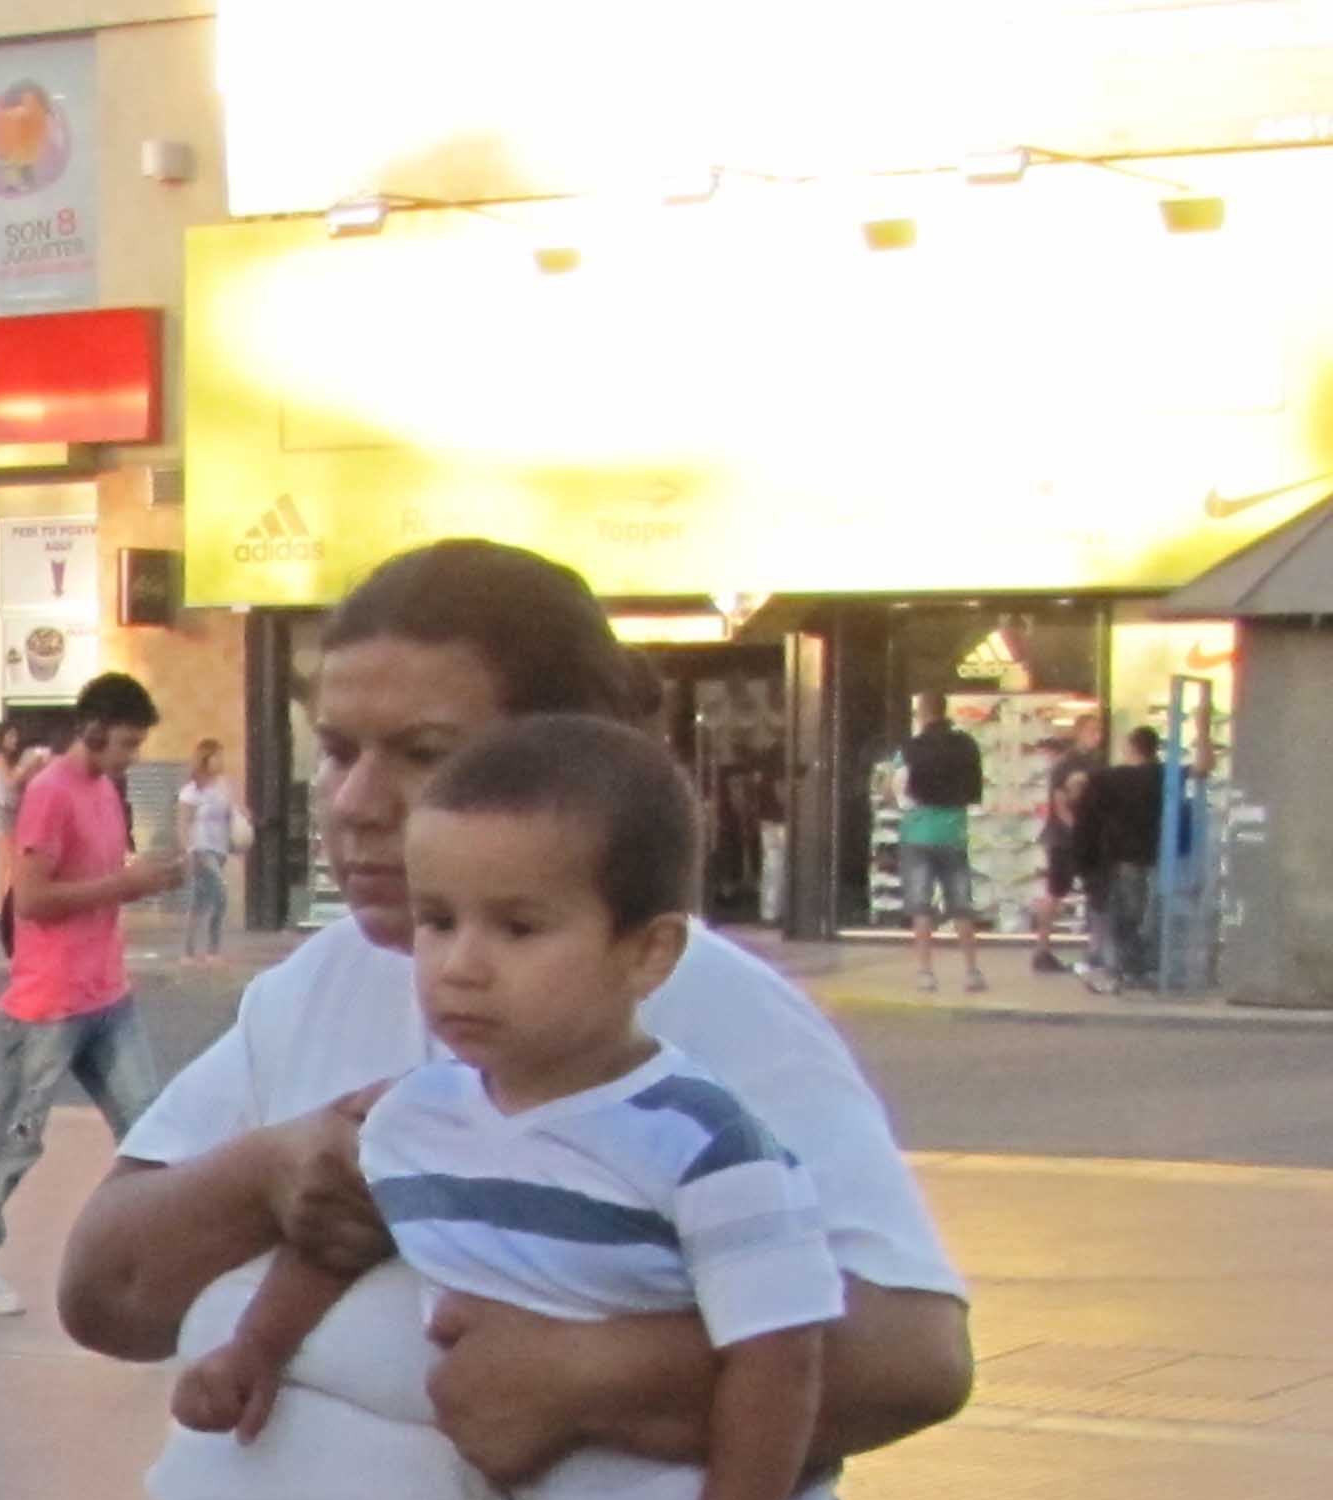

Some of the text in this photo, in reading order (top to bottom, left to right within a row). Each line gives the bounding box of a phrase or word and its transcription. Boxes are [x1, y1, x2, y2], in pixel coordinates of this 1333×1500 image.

[4, 207, 76, 247] SON 8
[592, 518, 686, 548] Topper
[233, 537, 325, 564] adidas
